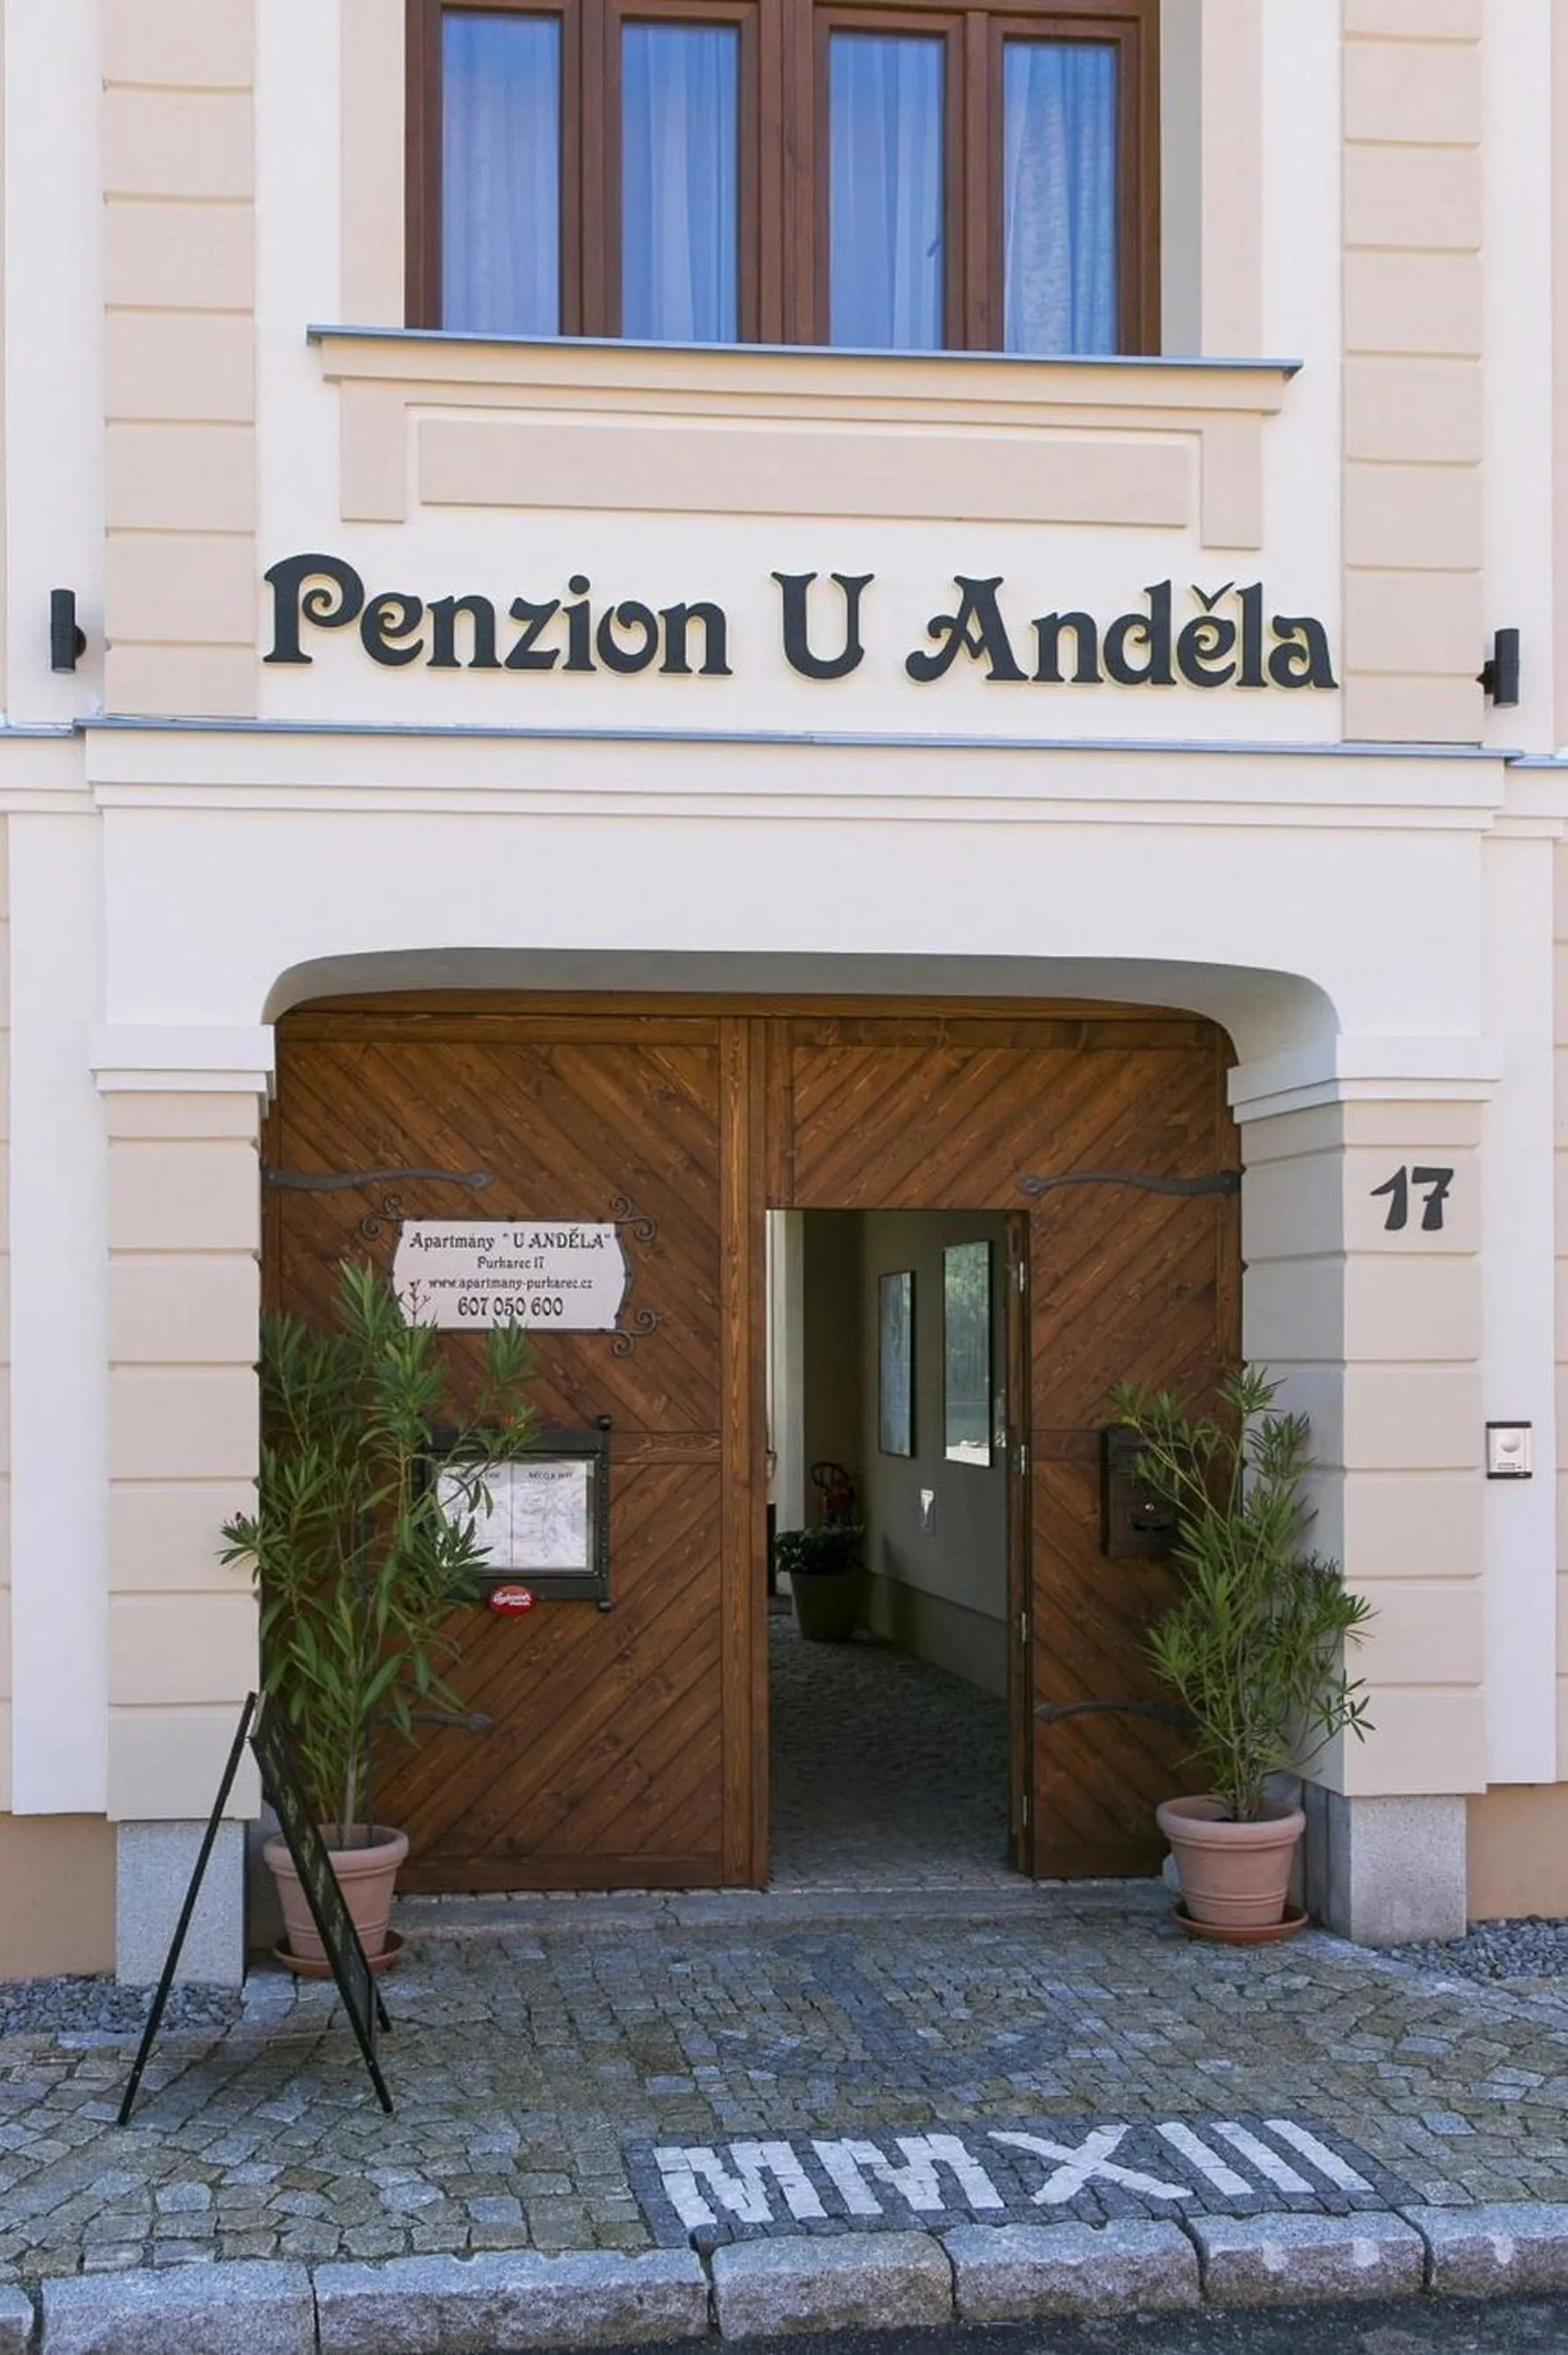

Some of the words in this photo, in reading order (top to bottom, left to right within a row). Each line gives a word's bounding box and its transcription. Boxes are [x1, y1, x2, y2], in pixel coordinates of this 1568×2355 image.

[263, 553, 733, 675] Penzion
[771, 571, 874, 679] U
[906, 576, 1339, 689] Anděla
[1370, 1165, 1454, 1231] 17
[457, 1296, 488, 1316] 607
[494, 1296, 526, 1316] 050
[531, 1296, 563, 1316] 600
[653, 2118, 1374, 2226] MMXIII
